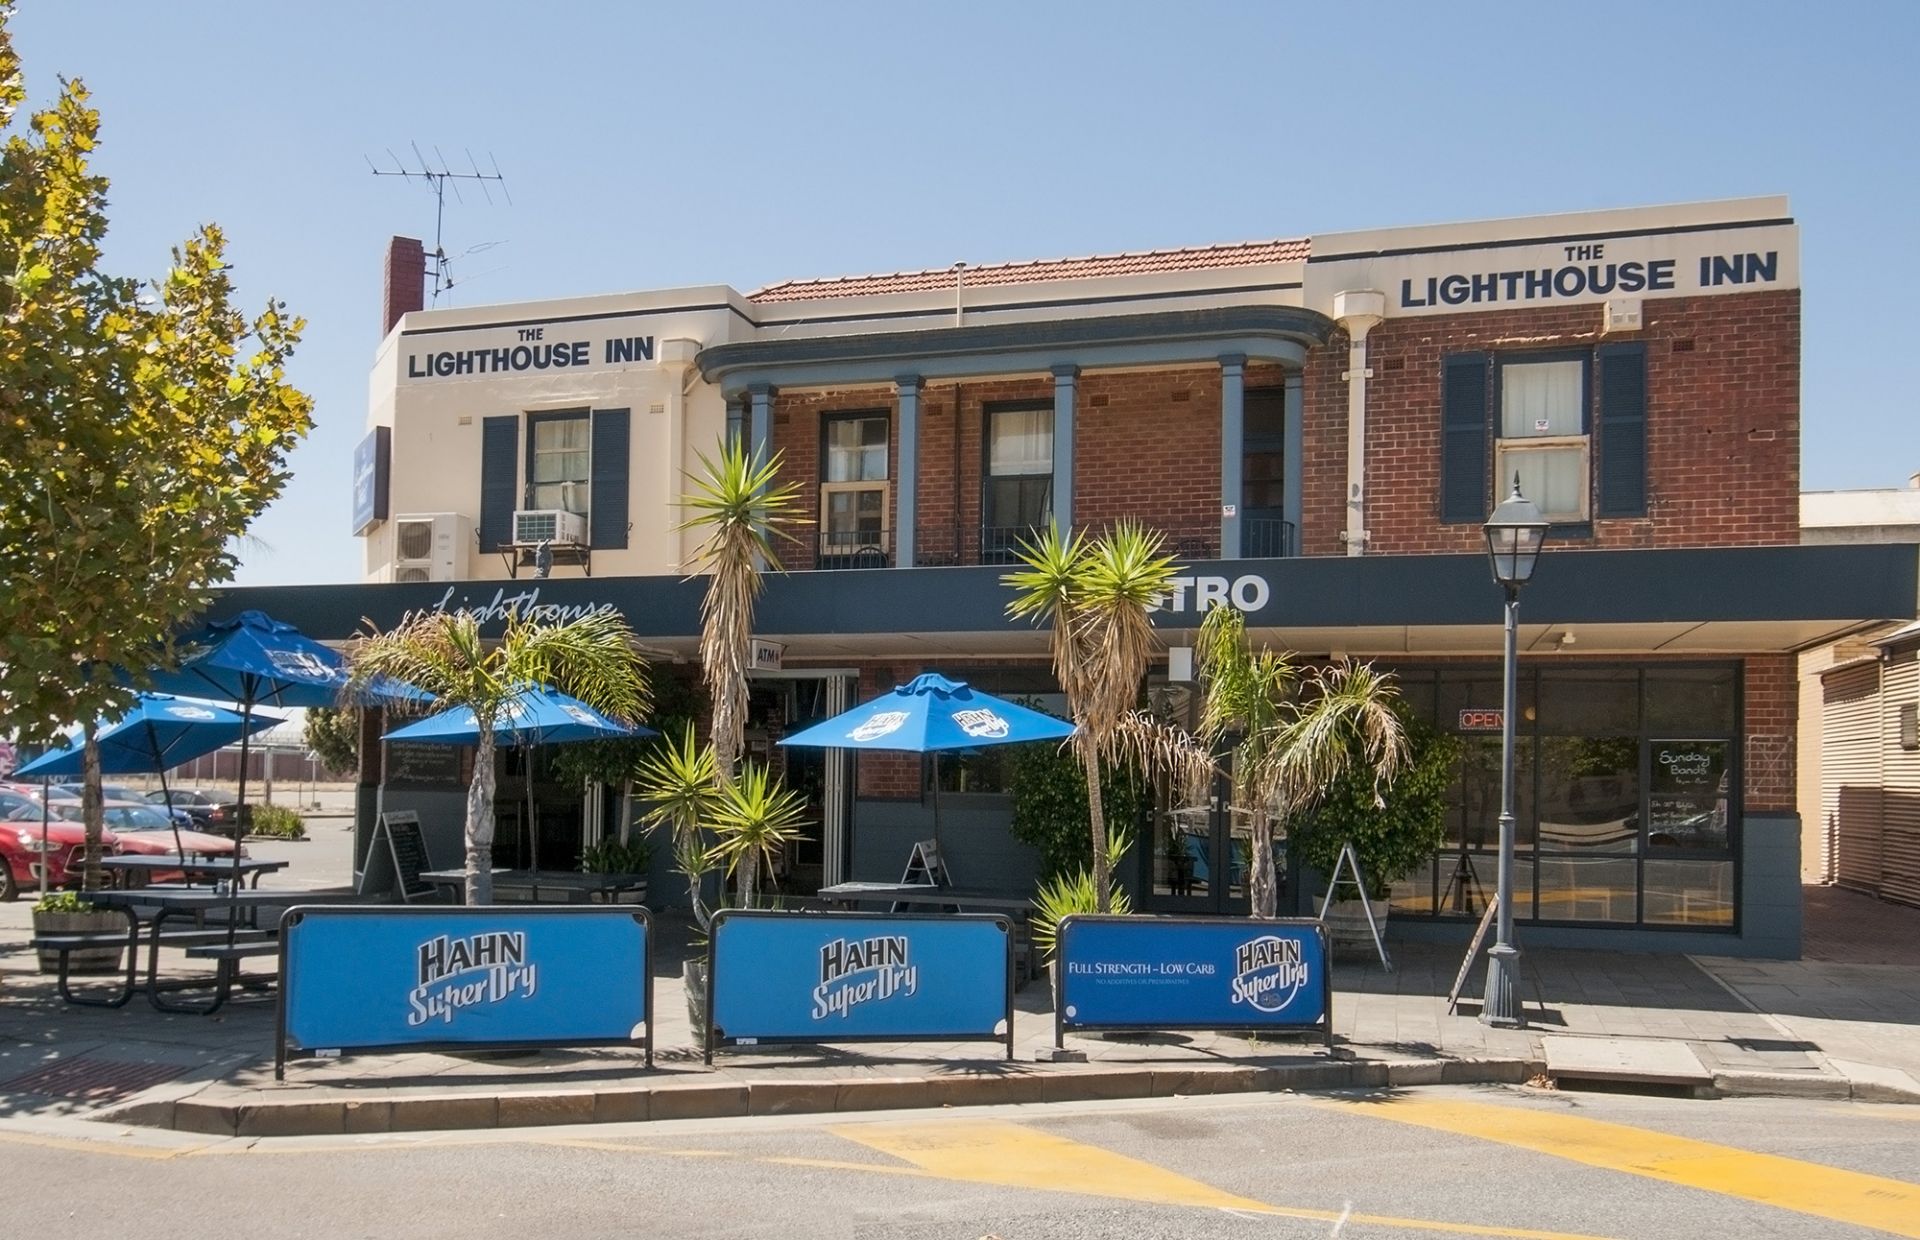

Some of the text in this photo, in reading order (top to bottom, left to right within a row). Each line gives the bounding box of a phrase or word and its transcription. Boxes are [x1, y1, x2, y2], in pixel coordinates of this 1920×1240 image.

[1564, 244, 1604, 262] THE
[1401, 251, 1778, 308] LIGHTHOUSE INN
[517, 328, 544, 342] THE
[408, 336, 654, 378] LIGHTHOUSE INN
[757, 647, 775, 663] ATM
[1462, 713, 1504, 727] OPEN
[1659, 750, 1710, 768] Sunday
[1670, 765, 1707, 775] Bands
[418, 931, 525, 987] HAHN
[820, 936, 909, 986] HAHN
[1236, 939, 1300, 977] HAHN
[1069, 962, 1093, 974] FULL
[1095, 962, 1151, 974] STRENGTH
[1161, 963, 1185, 974] LOW
[1186, 963, 1216, 974] CARB
